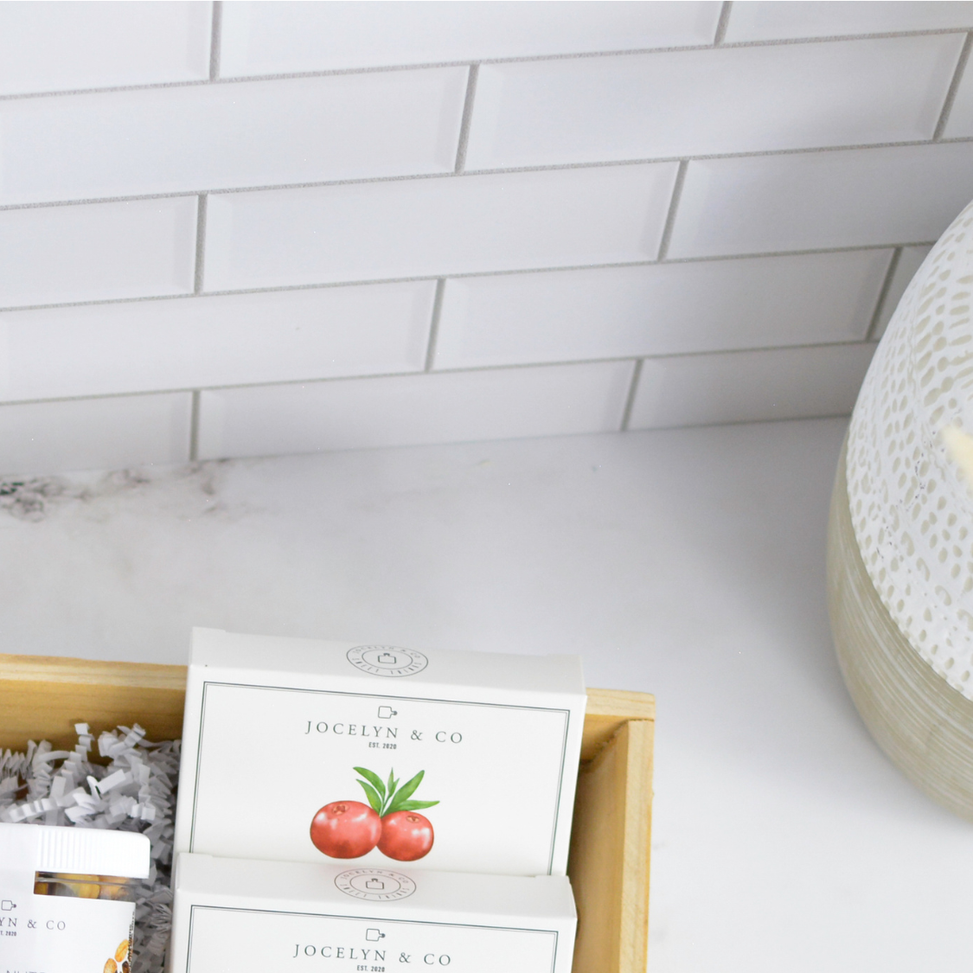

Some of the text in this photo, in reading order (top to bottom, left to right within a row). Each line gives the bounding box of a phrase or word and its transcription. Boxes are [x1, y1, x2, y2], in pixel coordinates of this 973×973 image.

[305, 720, 463, 744] JOCELYN & CO
[27, 920, 36, 928] &
[46, 920, 66, 930] CO
[293, 944, 451, 966] JOCELYN & CO
